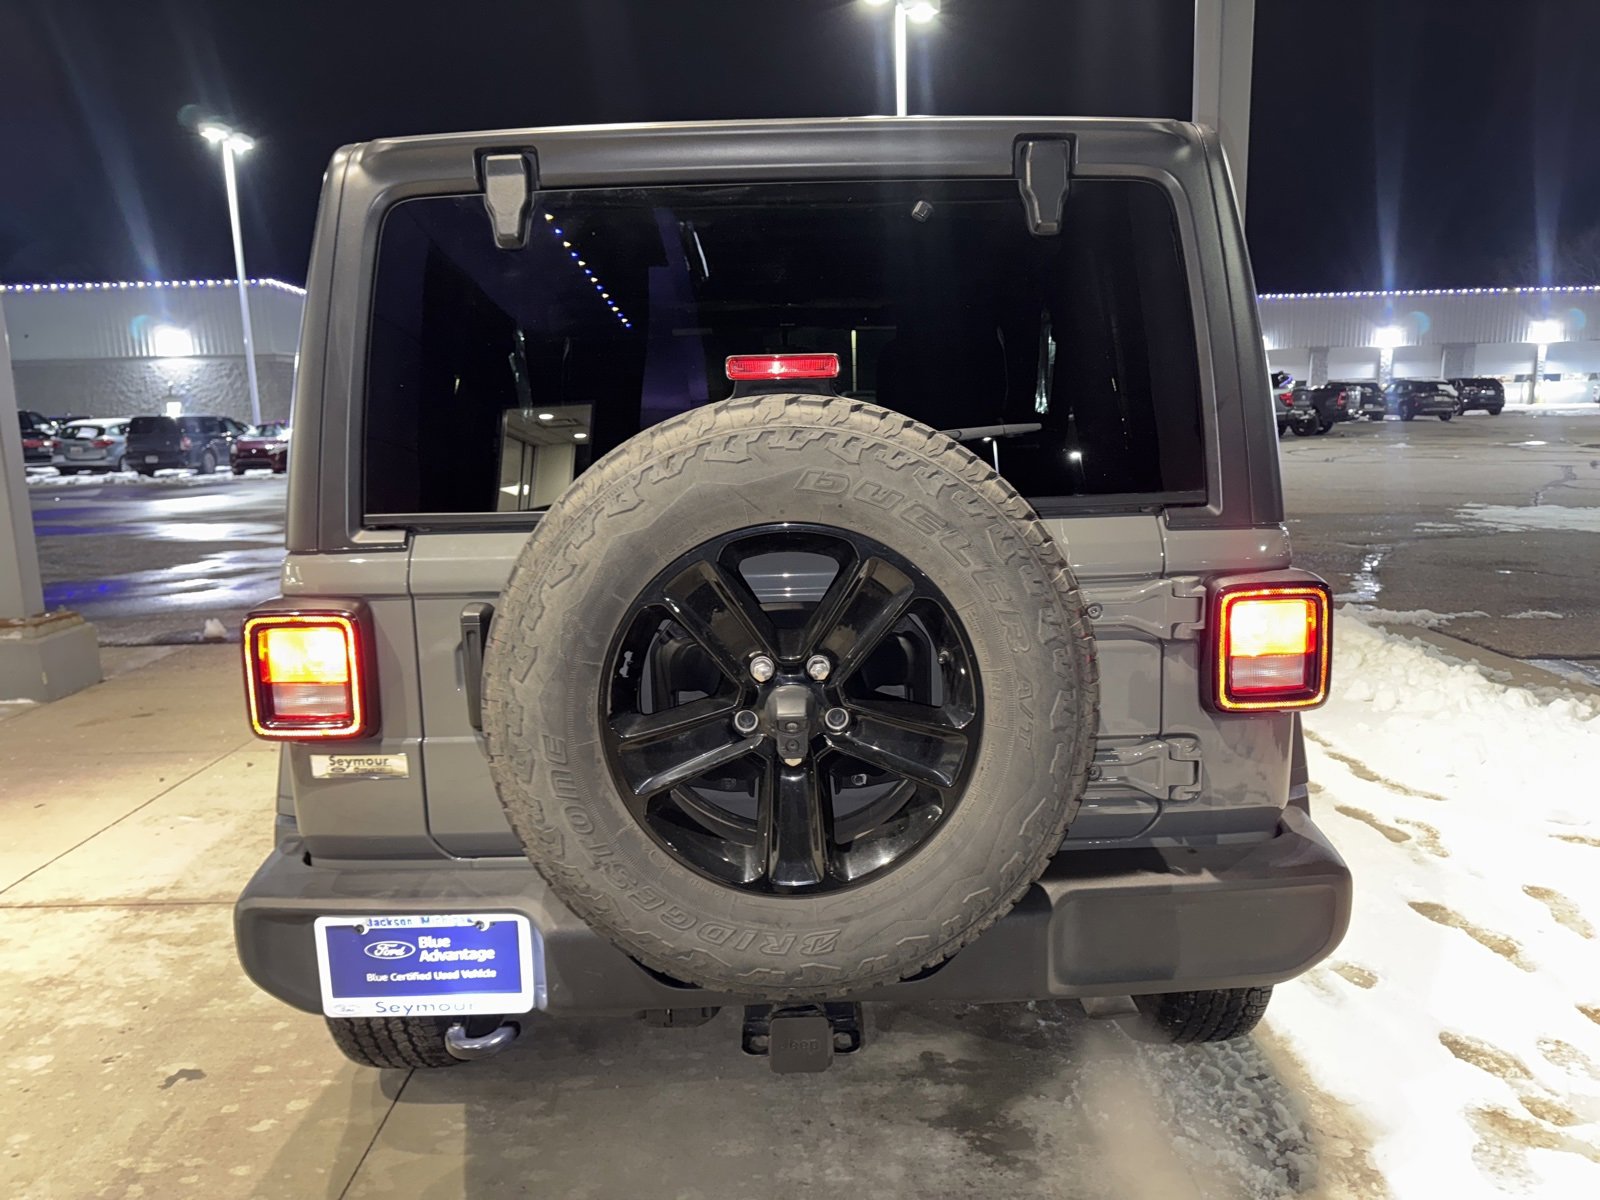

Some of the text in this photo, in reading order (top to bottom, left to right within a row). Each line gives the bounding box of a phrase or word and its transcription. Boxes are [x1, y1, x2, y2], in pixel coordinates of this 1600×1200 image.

[793, 467, 1031, 652] DUELER
[329, 755, 389, 768] Seymour
[540, 733, 842, 957] BRIDGESTONE
[366, 917, 413, 927] Jackson
[418, 936, 451, 948] Blue
[371, 943, 409, 957] Ford
[419, 949, 495, 962] Advantage
[366, 968, 498, 982] Blue Certified Used Vehicle
[375, 1001, 473, 1016] Seymour
